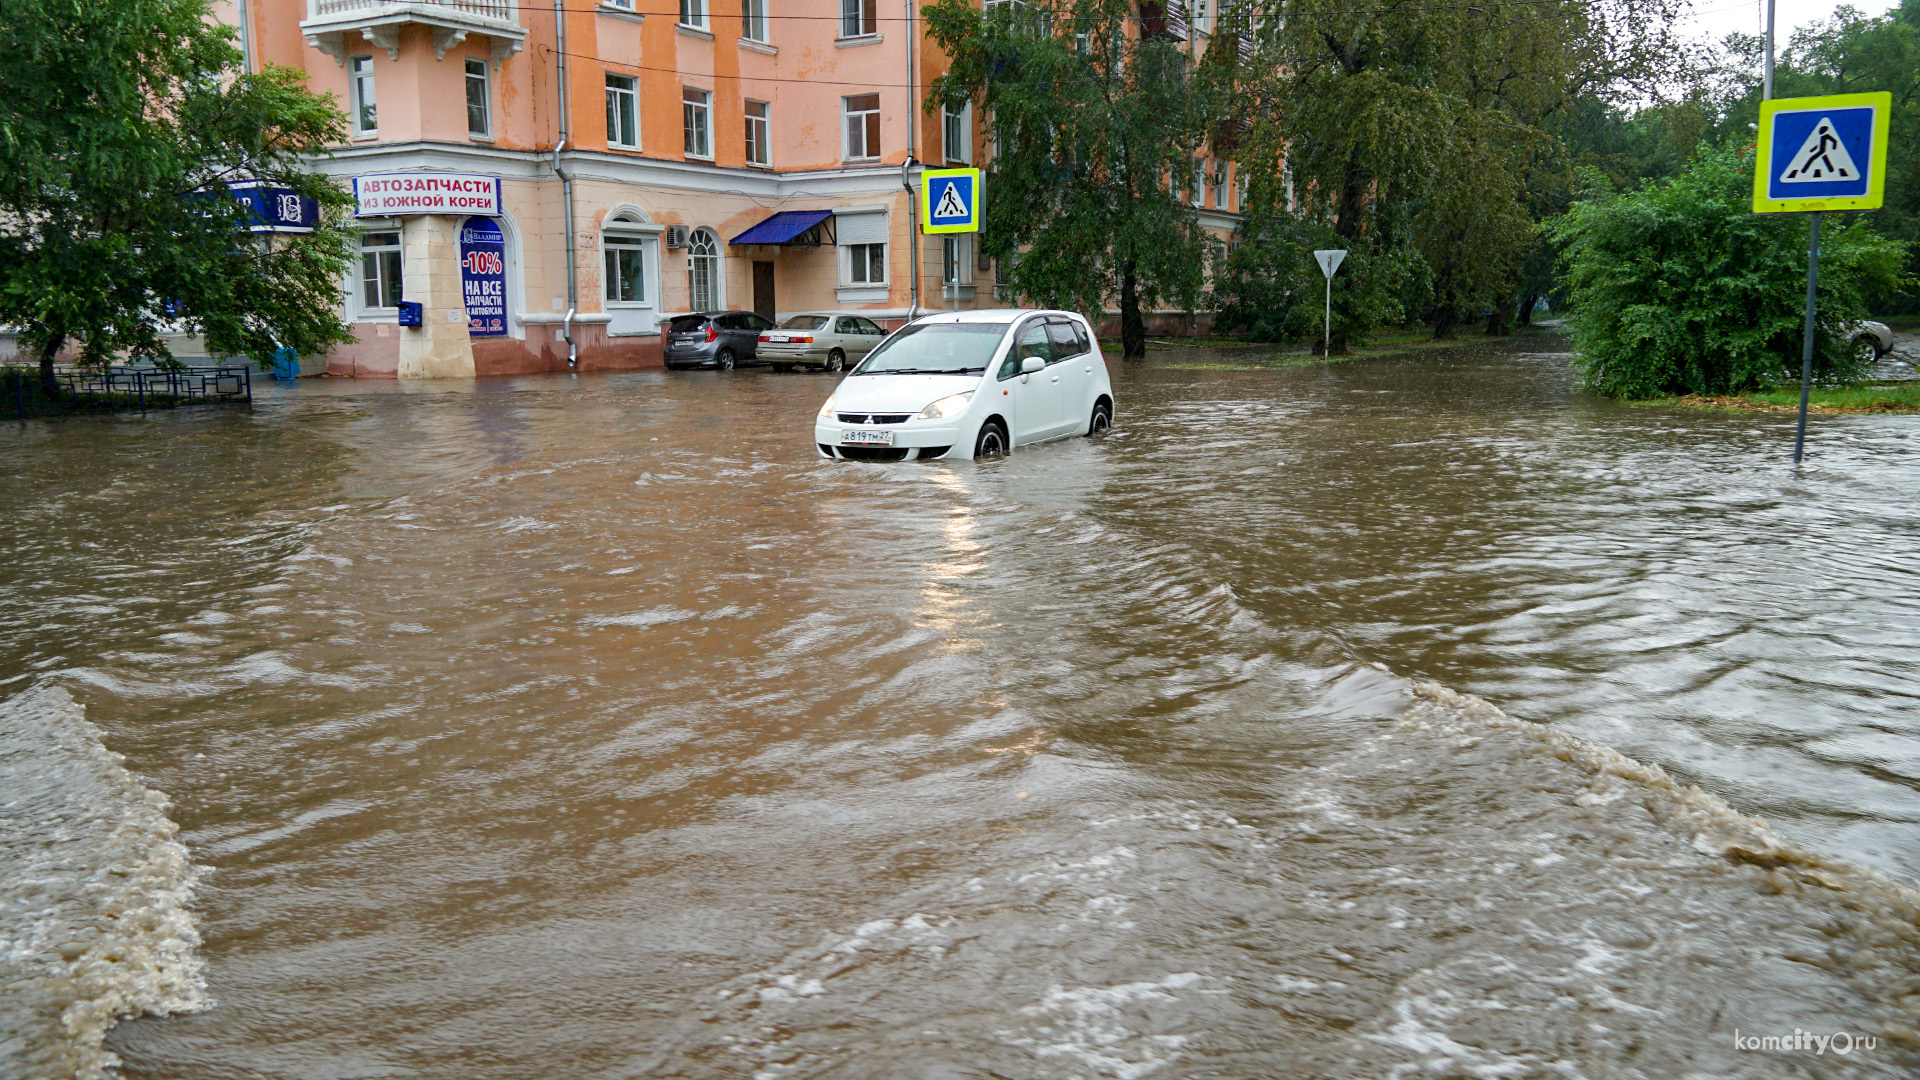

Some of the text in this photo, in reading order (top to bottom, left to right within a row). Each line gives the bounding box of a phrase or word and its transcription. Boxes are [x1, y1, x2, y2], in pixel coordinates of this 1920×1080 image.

[363, 179, 491, 193] АВТОЗАПЧАСТИ
[363, 194, 492, 209] ИЗ ЮЖНОЙ КОРЕИ
[462, 251, 503, 275] -10%
[465, 280, 502, 296] НА ВСЕ
[466, 295, 503, 306] ЗАПЧАСТИ
[471, 306, 503, 316] АВТОБУСАМ
